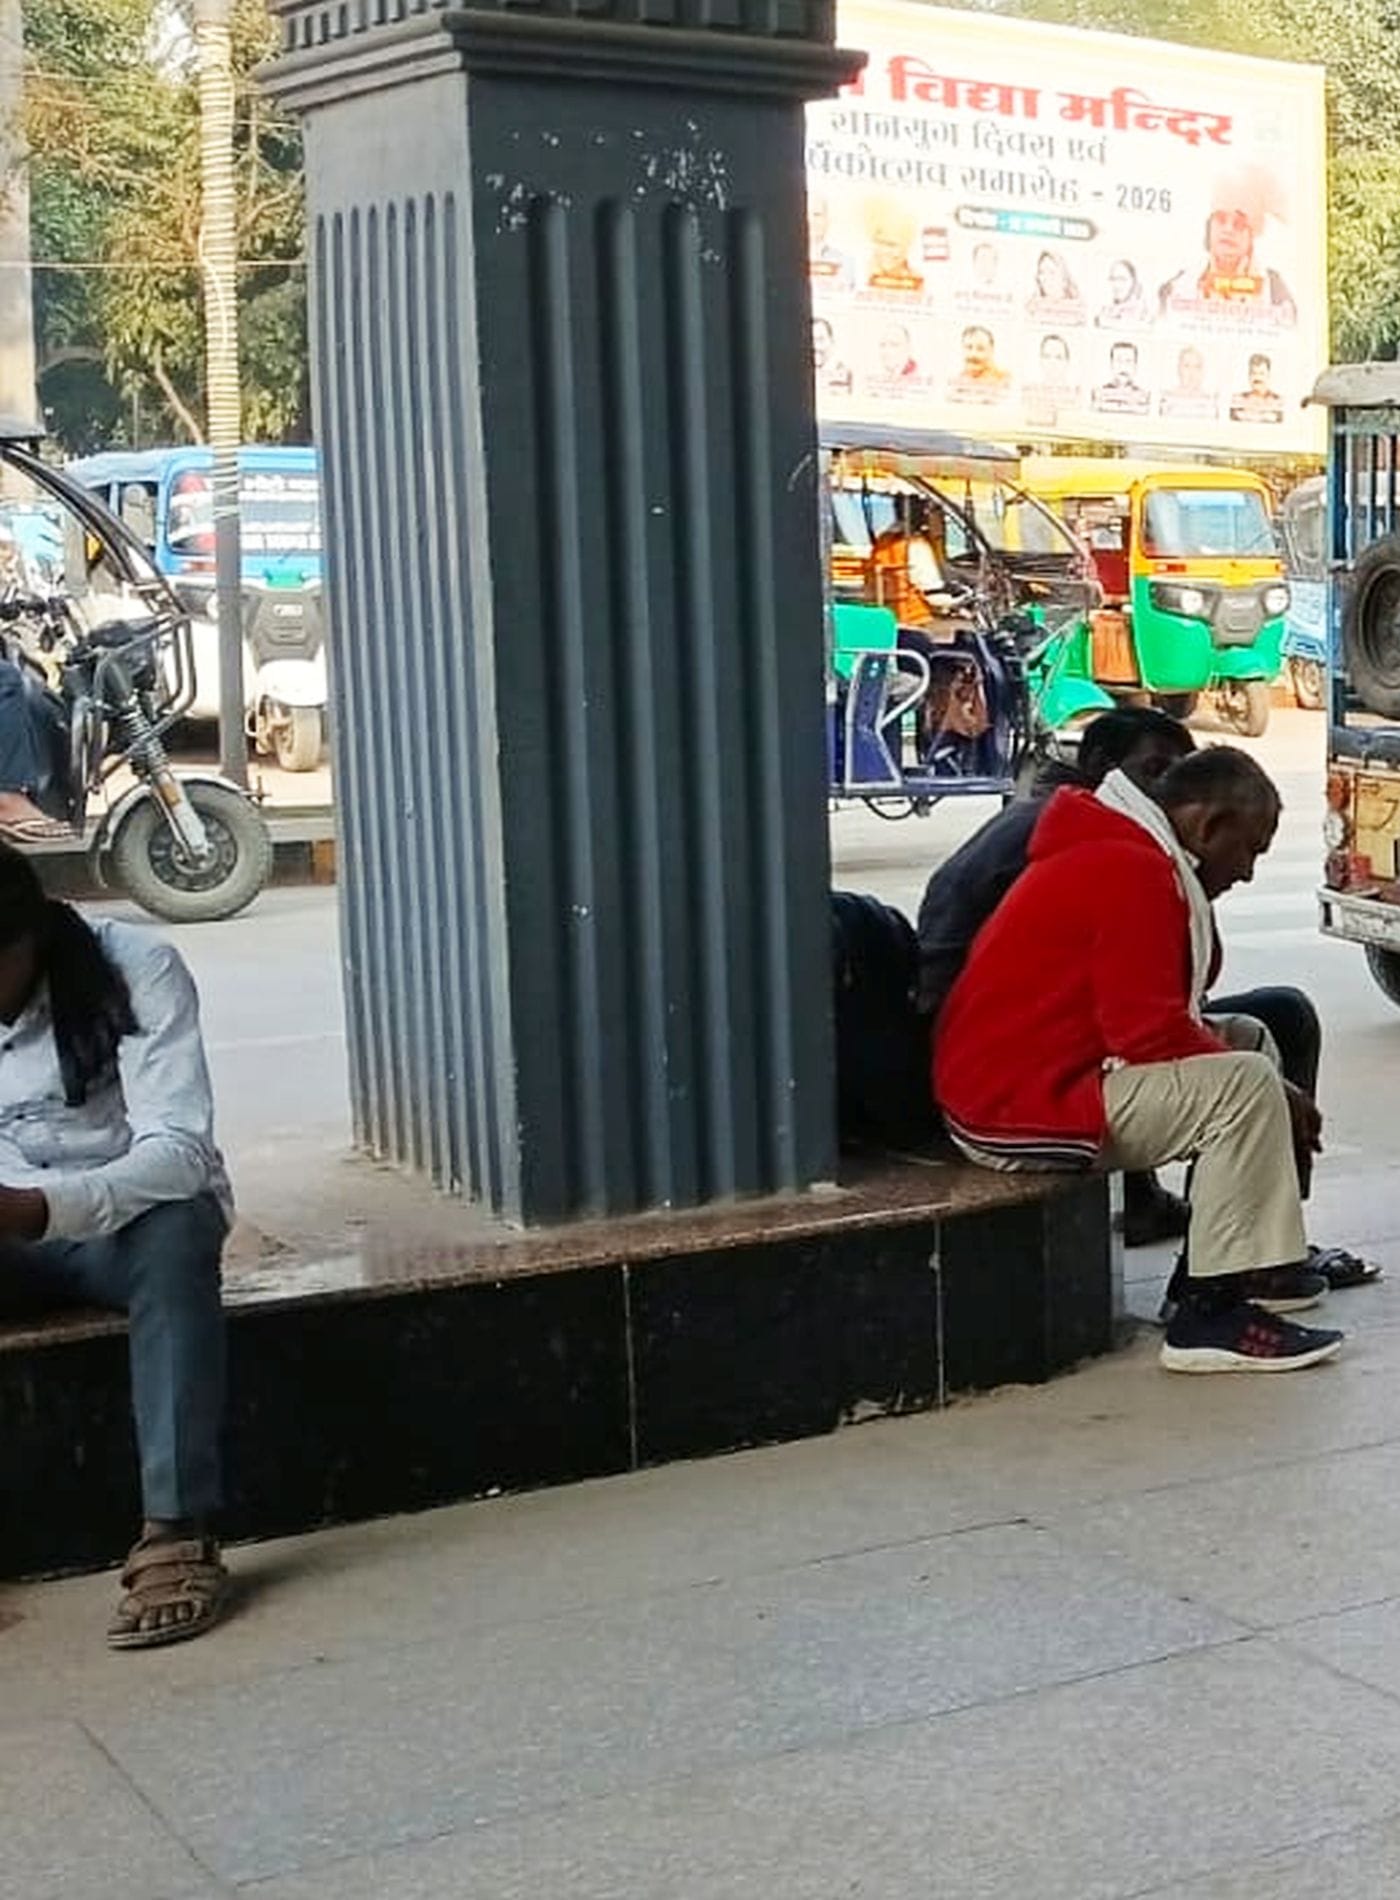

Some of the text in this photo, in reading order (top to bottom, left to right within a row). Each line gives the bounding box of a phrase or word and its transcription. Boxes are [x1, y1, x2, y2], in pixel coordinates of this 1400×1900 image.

[885, 55, 1041, 119] विद्या
[1056, 87, 1232, 146] मन्दिर
[1115, 182, 1173, 214] 2026
